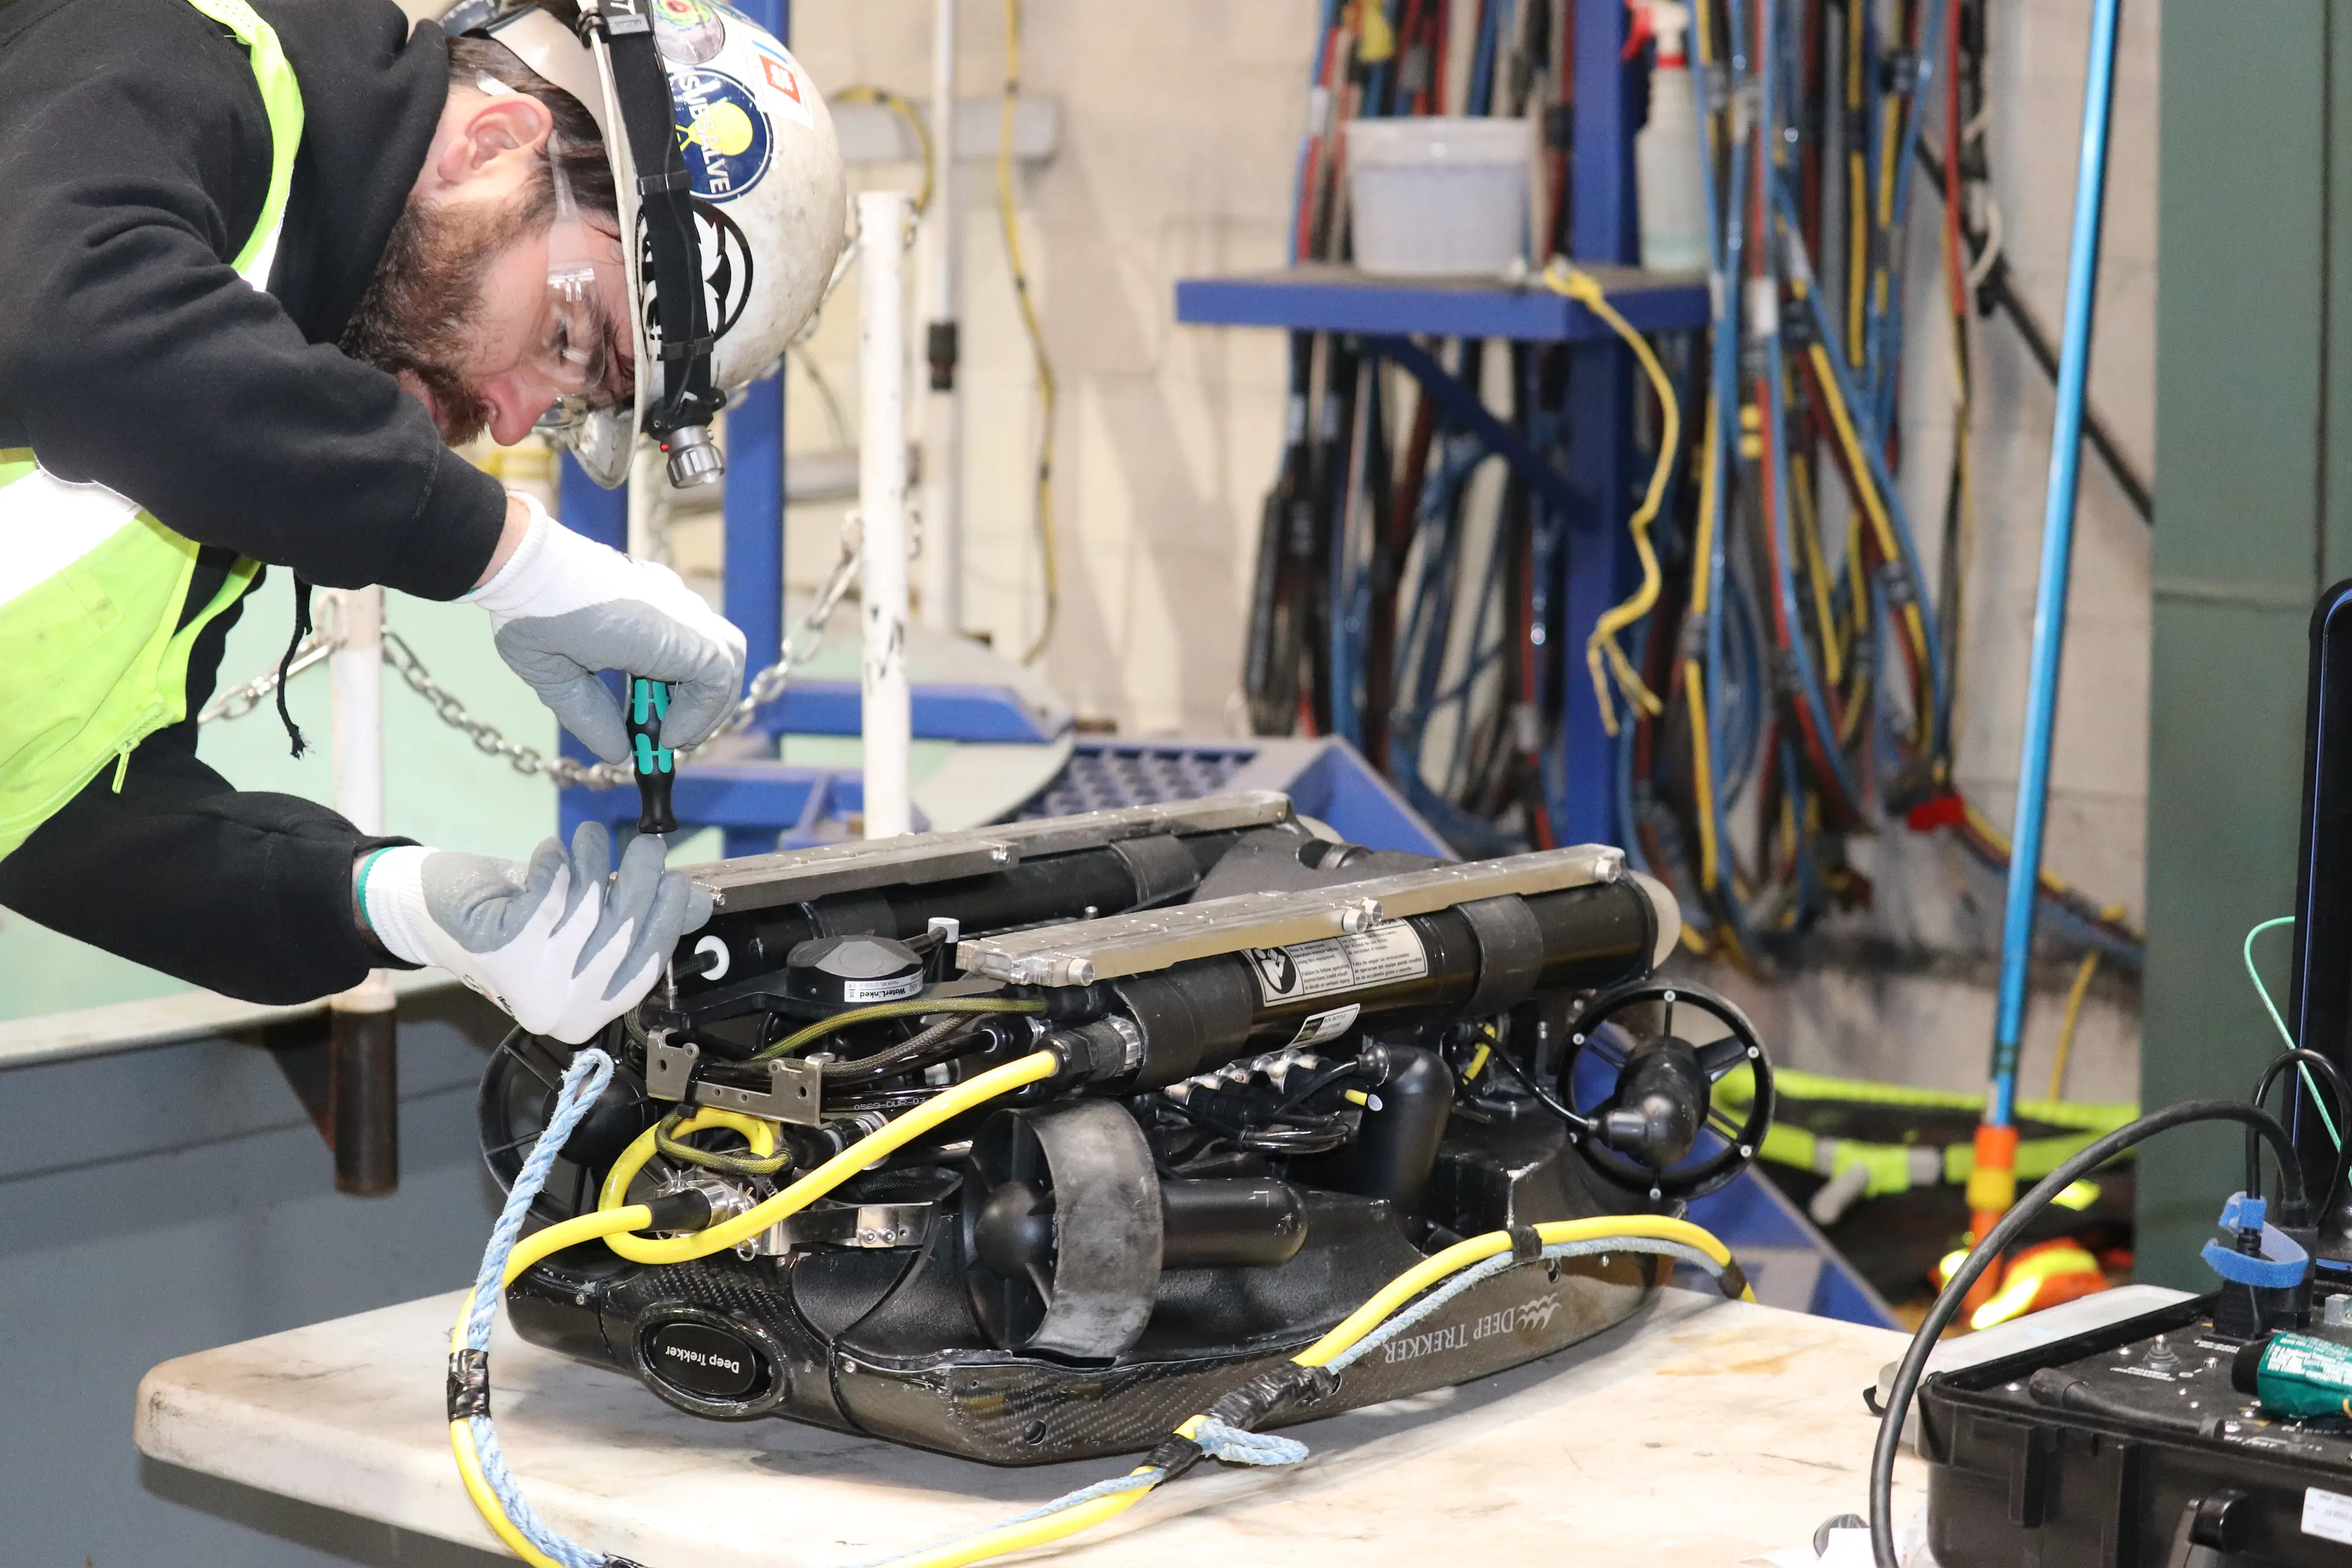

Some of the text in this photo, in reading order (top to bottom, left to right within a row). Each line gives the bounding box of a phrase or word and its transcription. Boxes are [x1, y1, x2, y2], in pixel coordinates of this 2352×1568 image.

[679, 75, 731, 193] SUBSALVE
[665, 1346, 739, 1374] Deep Trekker
[1383, 1307, 1515, 1363] DEEP TREKKER
